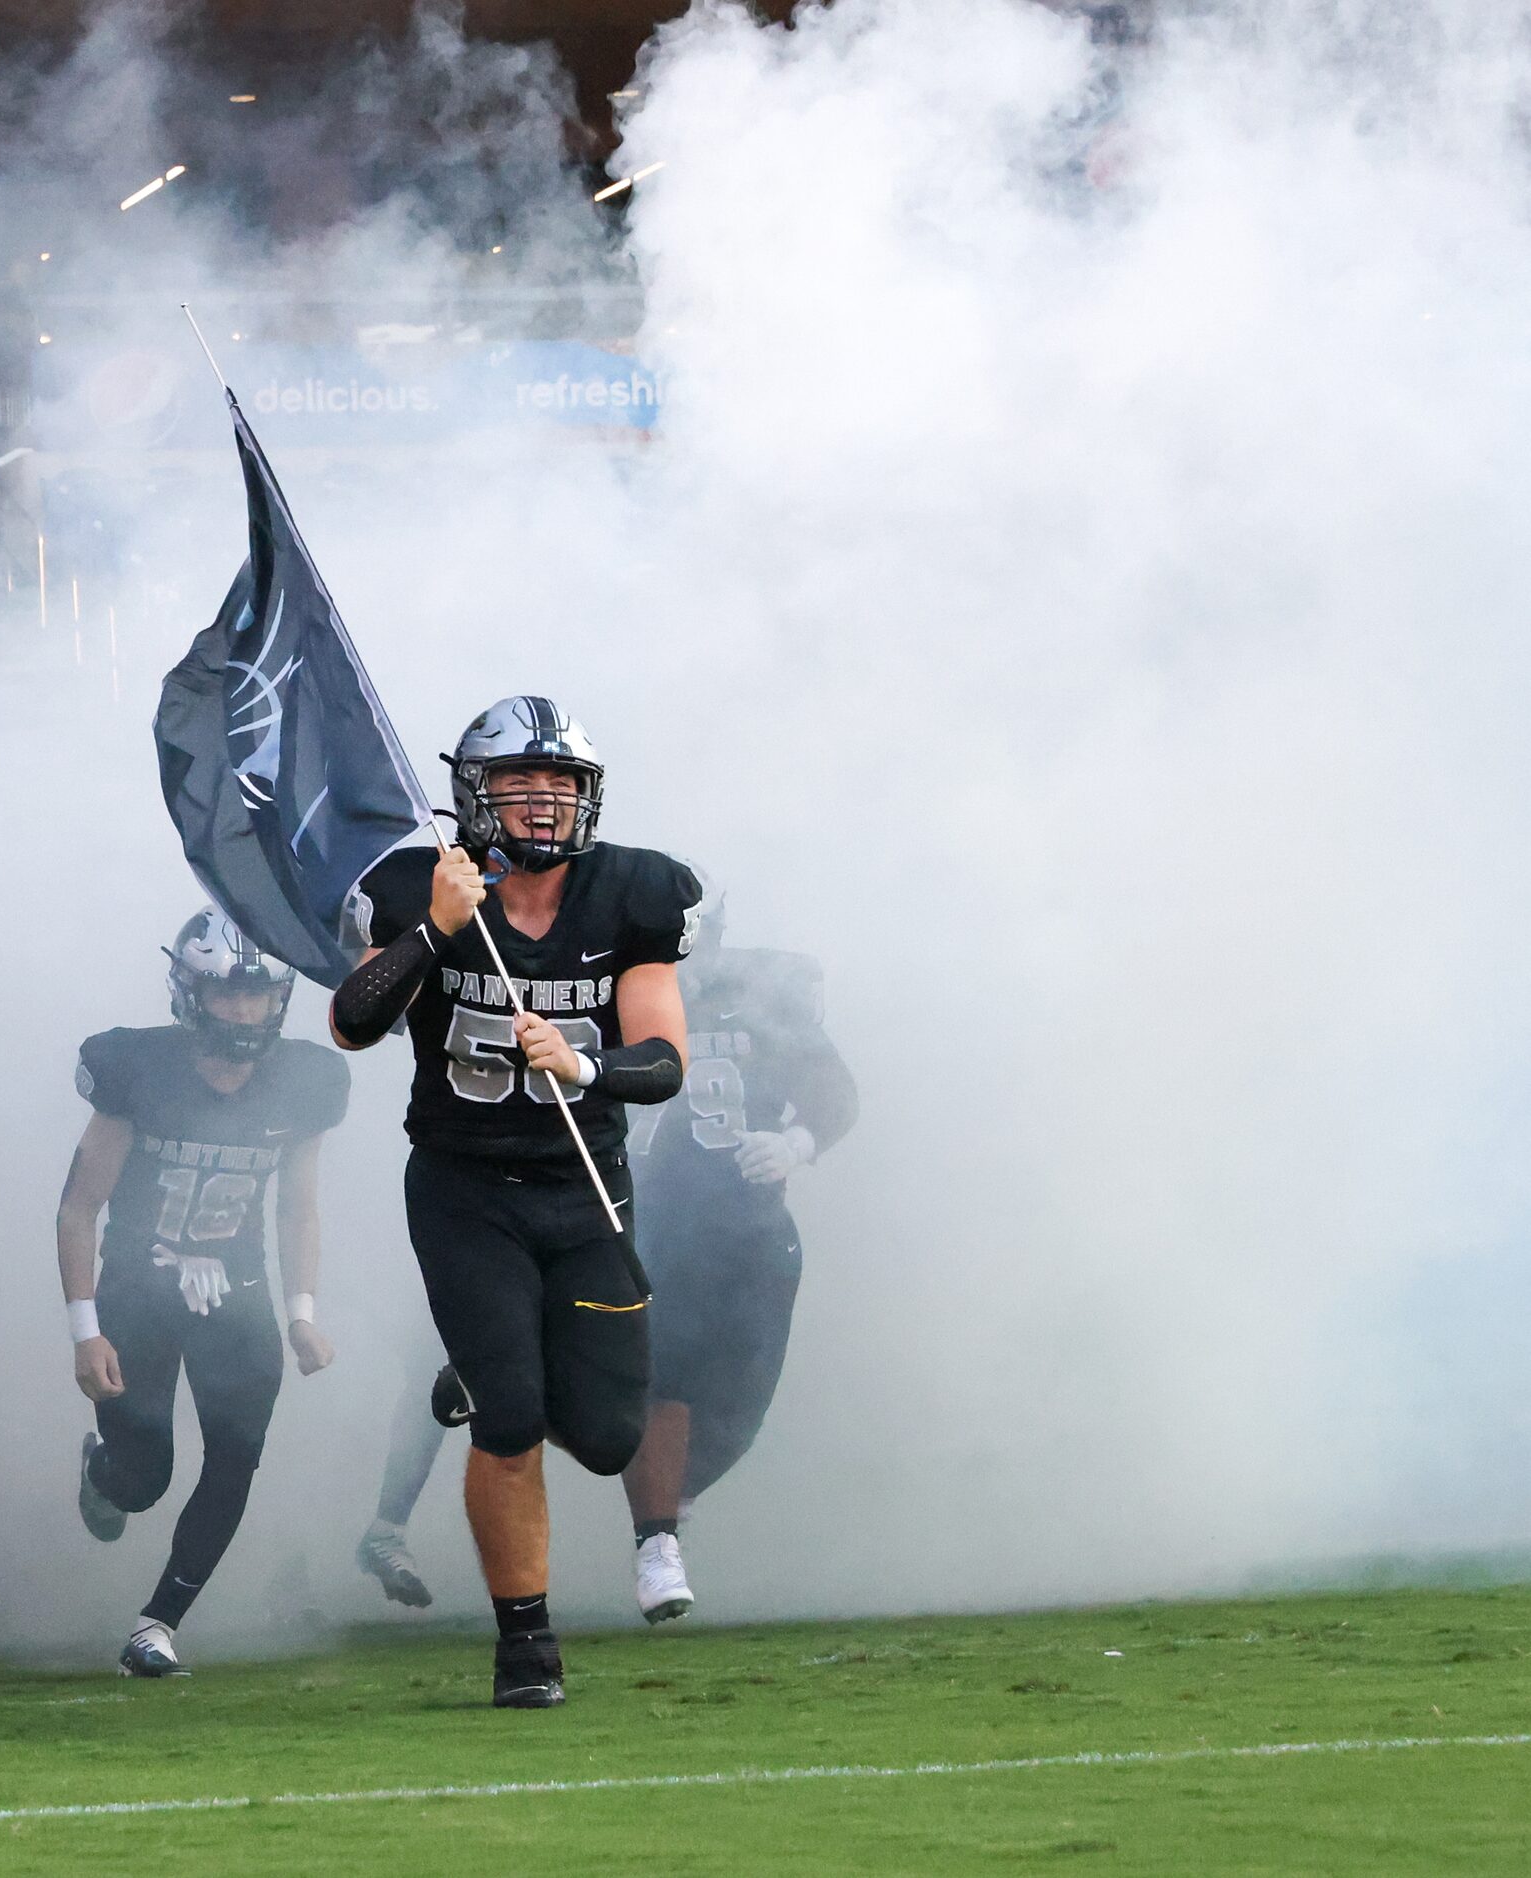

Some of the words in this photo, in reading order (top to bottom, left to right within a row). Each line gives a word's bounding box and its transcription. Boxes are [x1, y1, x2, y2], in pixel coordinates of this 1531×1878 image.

[254, 378, 439, 413] delicious.
[516, 371, 664, 408] refreshi
[441, 967, 613, 1011] PANTHERS
